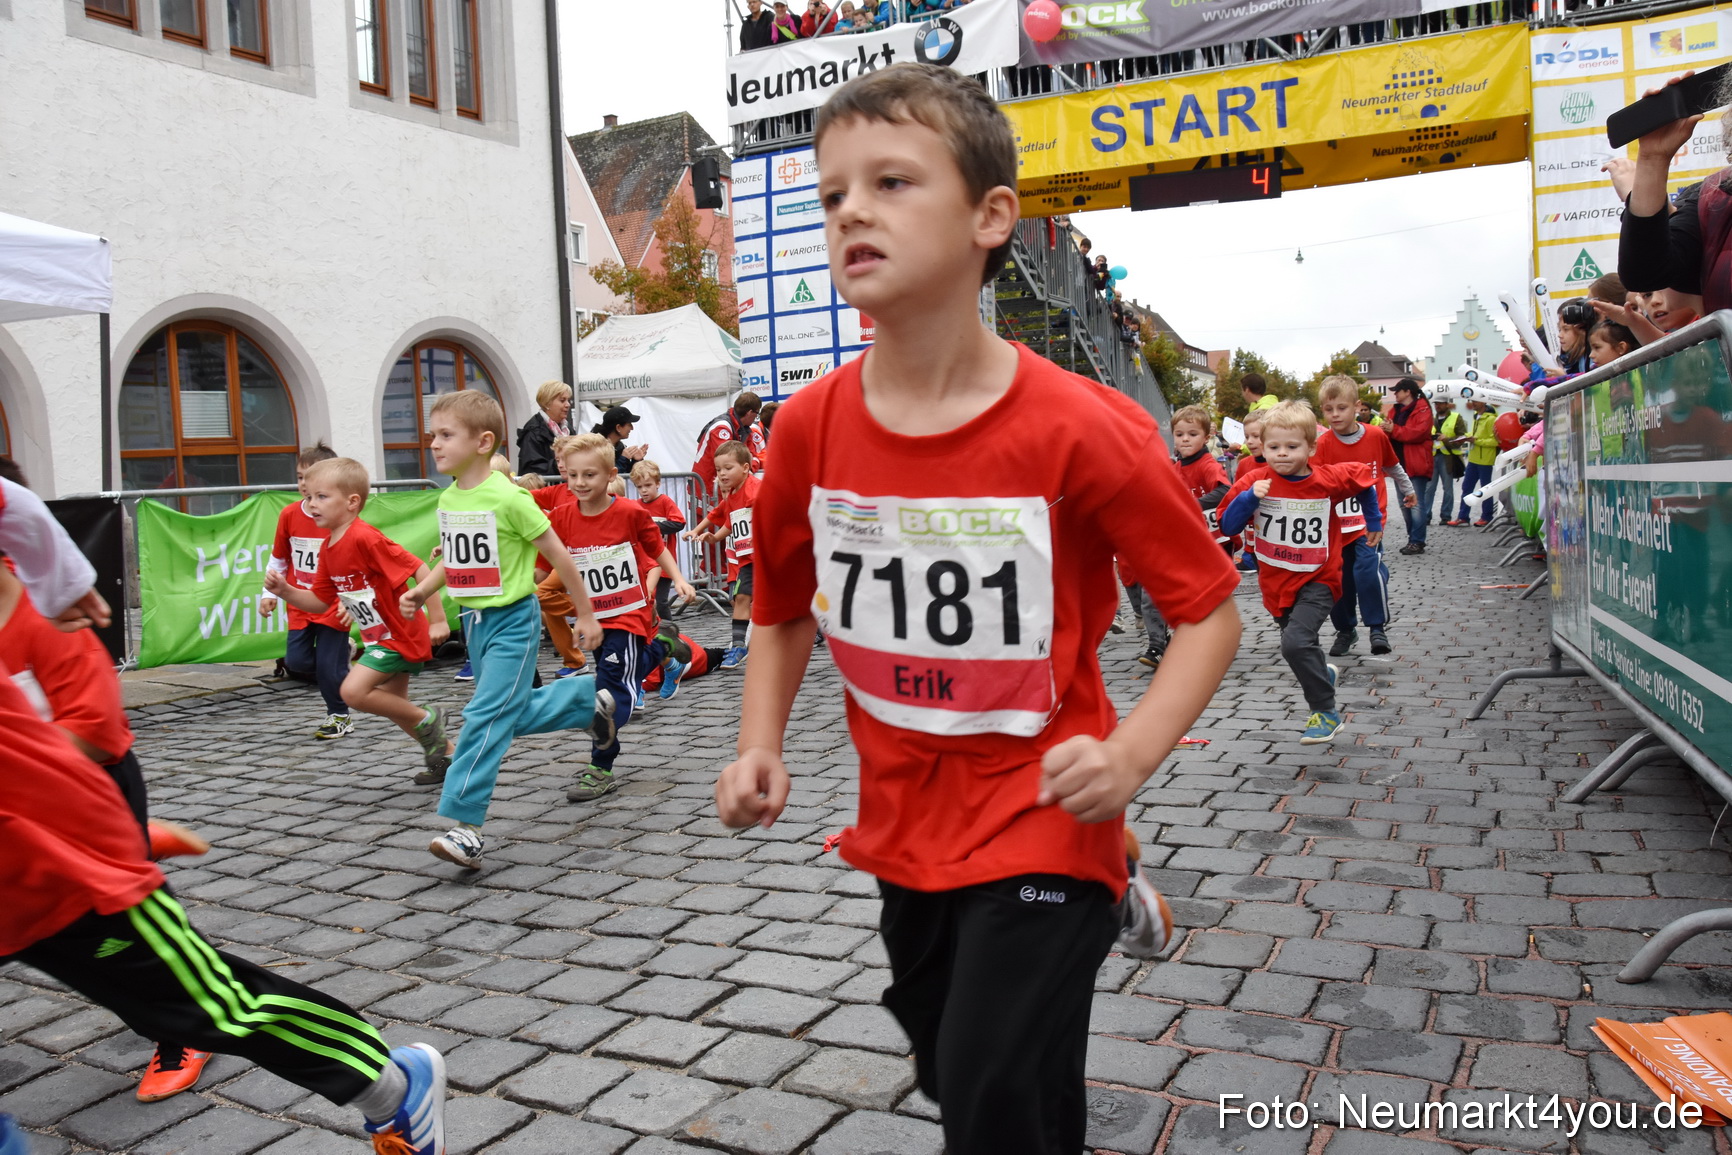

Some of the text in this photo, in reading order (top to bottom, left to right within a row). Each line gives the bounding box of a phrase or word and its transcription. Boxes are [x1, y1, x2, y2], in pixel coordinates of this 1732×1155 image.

[1061, 0, 1146, 28] OCK
[916, 18, 960, 41] BMW
[1069, 31, 1079, 41] by
[1081, 28, 1108, 38] smart
[1110, 24, 1151, 36] concepts
[1578, 56, 1619, 69] energie
[1341, 78, 1489, 110] Neumarkter Stadtlauf
[1561, 89, 1592, 108] RUND
[1090, 76, 1299, 153] START
[1372, 130, 1498, 157] Neumarkter Stadtlauf
[1538, 159, 1598, 172] RAIL.ONE
[1018, 179, 1122, 198] Neumarkter Stadtlauf
[1252, 167, 1270, 195] 4
[1563, 207, 1623, 221] VARIOTEC
[789, 243, 828, 256] VARIOTEC
[777, 331, 815, 342] RAIL.ONE
[780, 368, 813, 382] swn
[1286, 501, 1324, 511] BOCK
[448, 514, 488, 525] BOCK
[898, 507, 1025, 536] BOCK
[1260, 511, 1323, 545] 7183
[1591, 492, 1673, 554] Mehr Sicherheit
[195, 544, 274, 583] Her
[295, 549, 320, 570] 74
[591, 547, 627, 562] BOCK
[1273, 547, 1303, 562] Adam
[1606, 554, 1620, 600] Ihr
[1622, 561, 1659, 620] Event!
[593, 596, 624, 610] Moritz
[830, 550, 1020, 647] 7181
[893, 664, 955, 701] Erik
[1606, 638, 1613, 664] &
[1613, 642, 1634, 682] Service
[1634, 657, 1653, 696] Line:
[1653, 670, 1680, 715] 09181
[1681, 688, 1705, 735] 6352
[1037, 889, 1066, 903] JAKO
